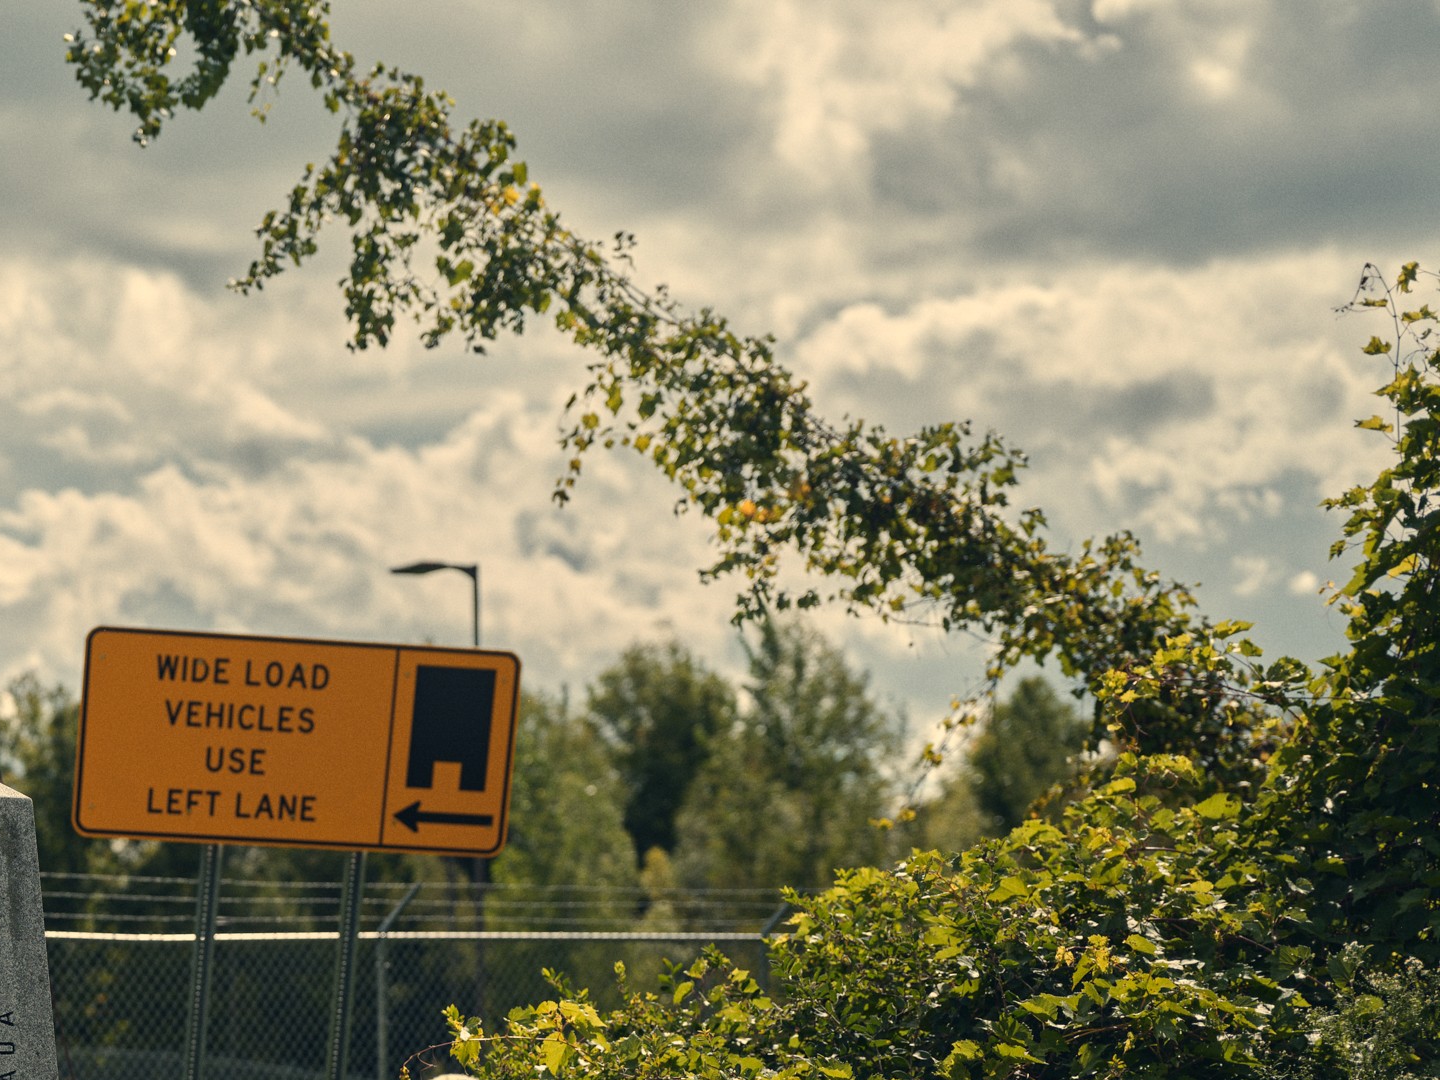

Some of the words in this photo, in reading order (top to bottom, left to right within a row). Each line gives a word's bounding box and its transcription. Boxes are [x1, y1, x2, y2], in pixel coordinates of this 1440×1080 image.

[157, 654, 229, 684] WIDE
[246, 659, 330, 690] LOAD
[166, 699, 315, 734] VEHICLES
[205, 746, 266, 775] USE
[147, 788, 220, 816] LEFT
[236, 792, 316, 821] LANE
